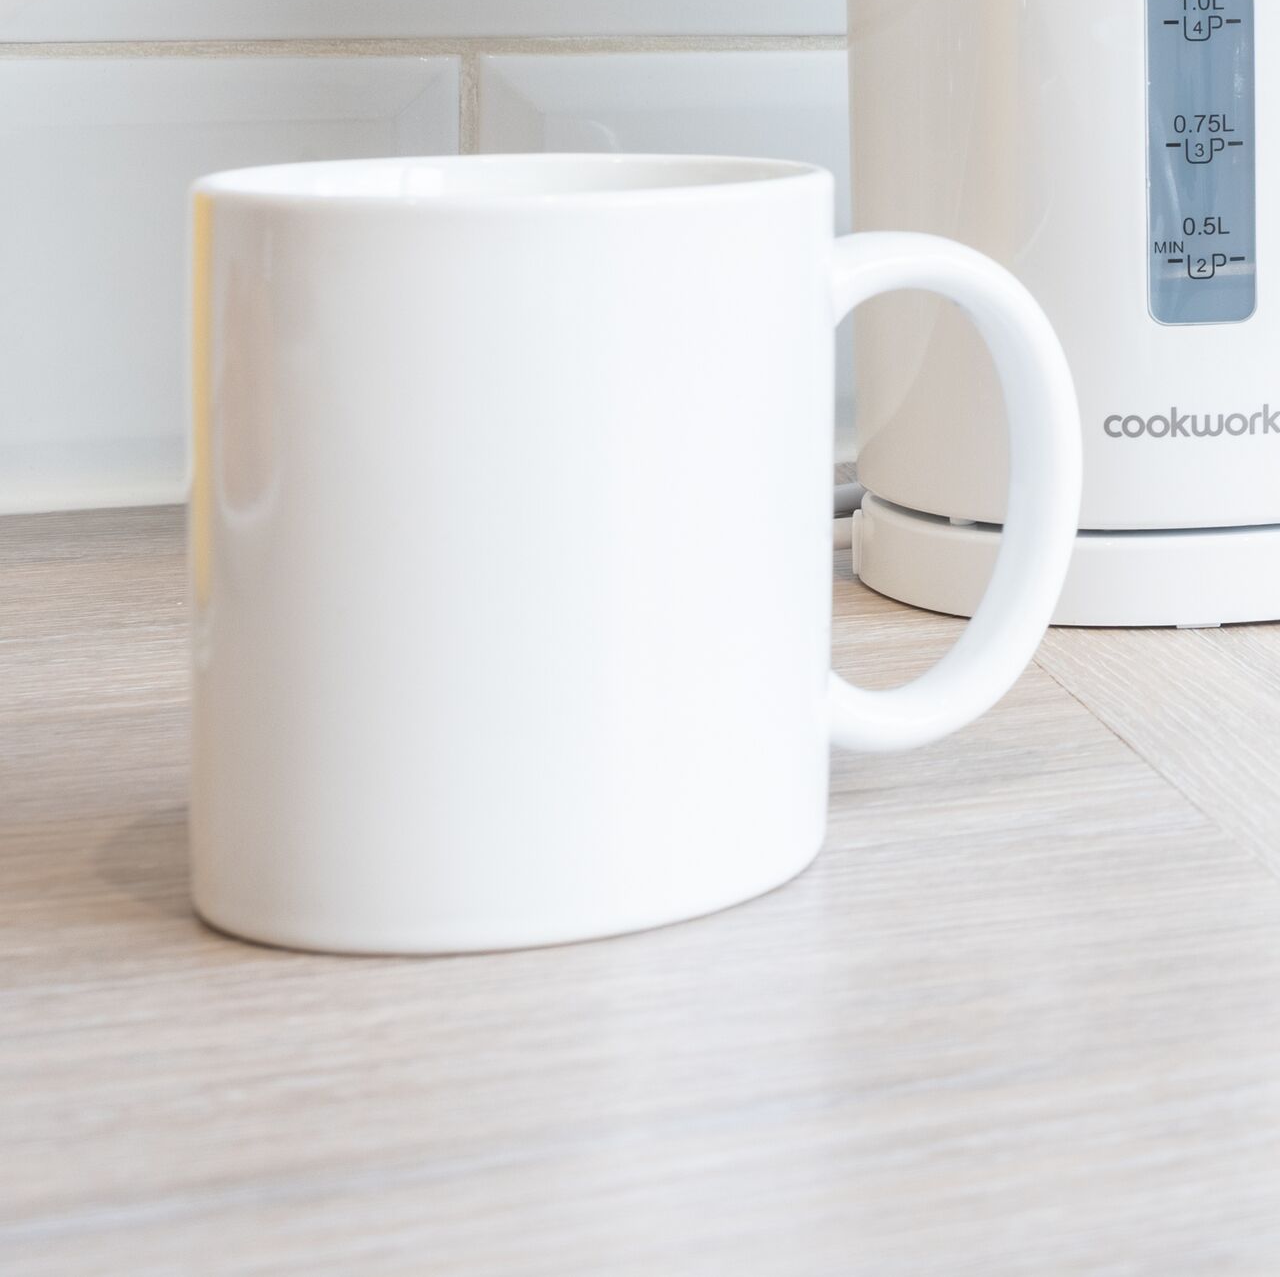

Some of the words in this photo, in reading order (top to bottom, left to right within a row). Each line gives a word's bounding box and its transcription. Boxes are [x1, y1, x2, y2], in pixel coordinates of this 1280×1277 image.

[1173, 114, 1235, 134] 0.75L
[1182, 216, 1231, 236] 0.5L
[1154, 241, 1184, 254] MIN
